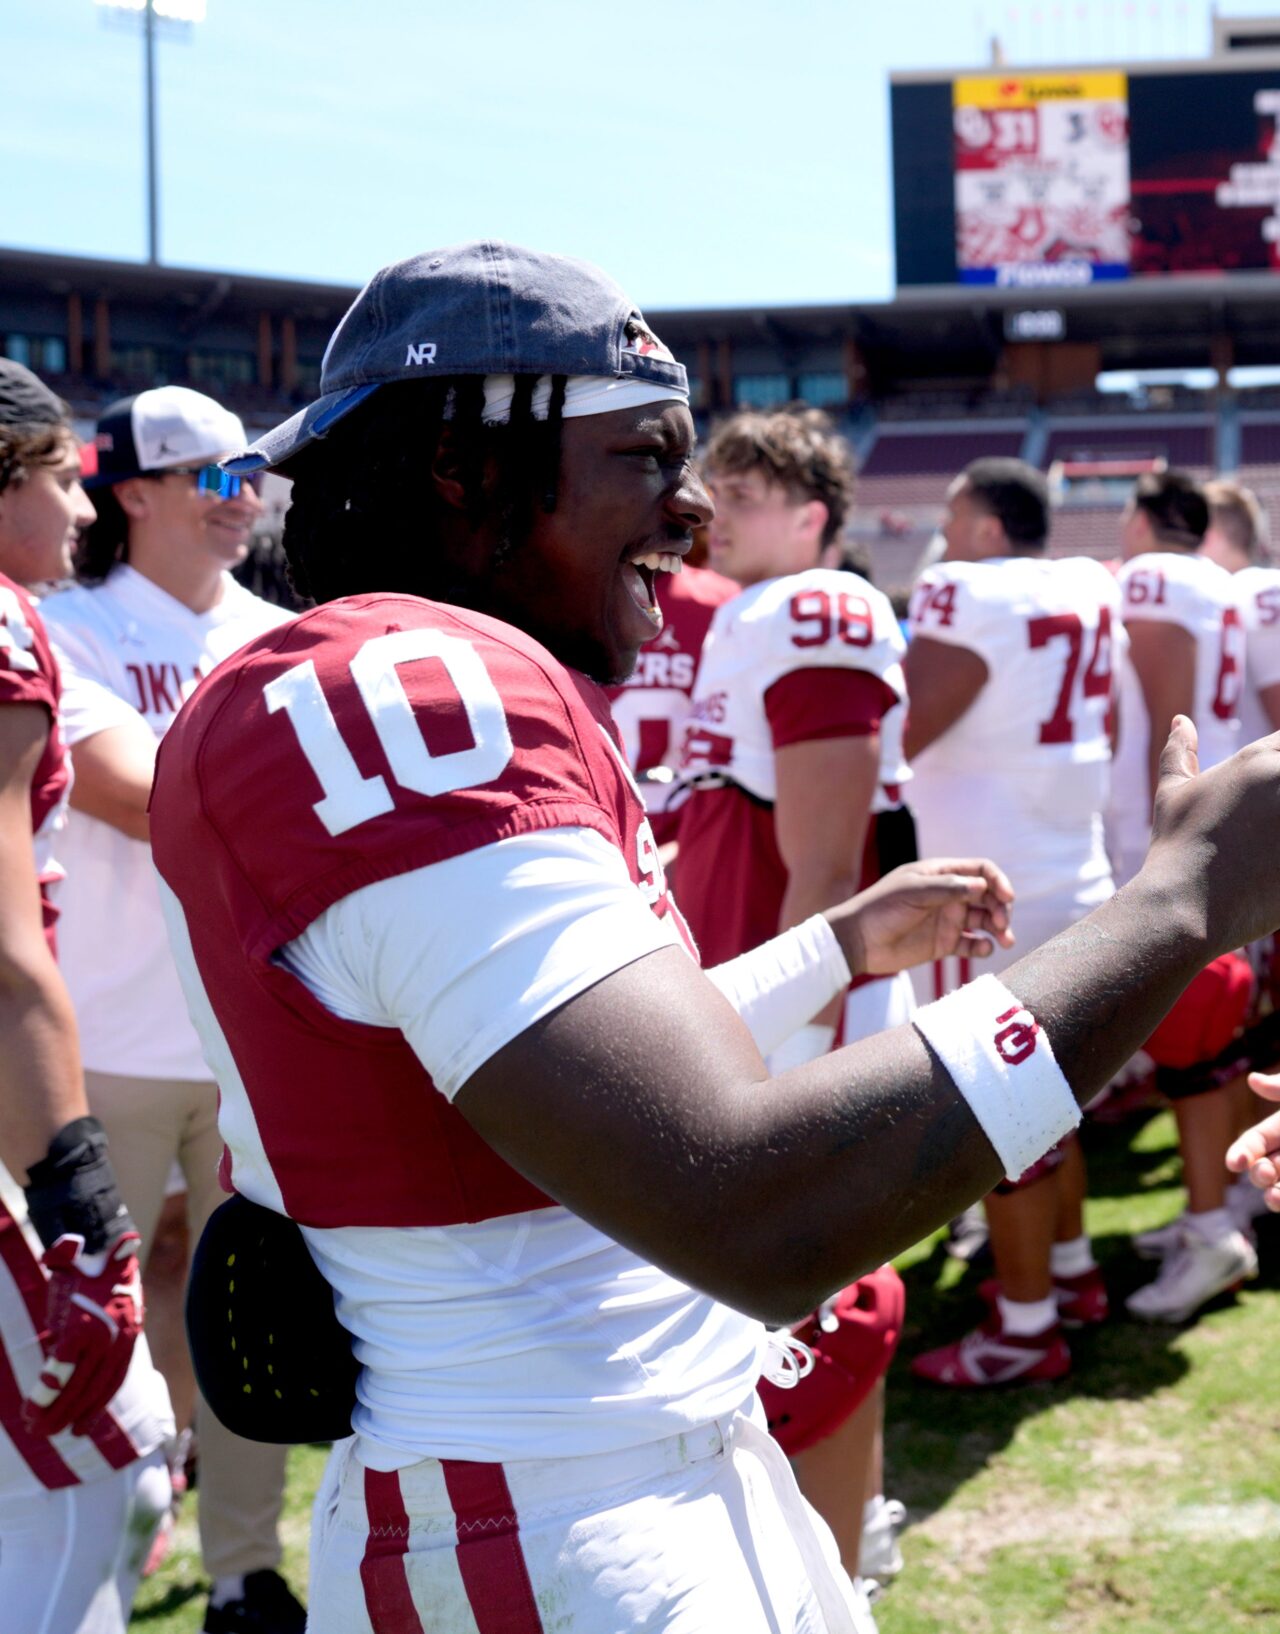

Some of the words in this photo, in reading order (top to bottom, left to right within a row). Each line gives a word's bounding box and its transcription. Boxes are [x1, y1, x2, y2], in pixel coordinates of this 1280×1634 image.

[405, 343, 437, 366] NR
[1127, 569, 1166, 605] 61
[790, 591, 873, 648] 98
[263, 628, 514, 837] 10
